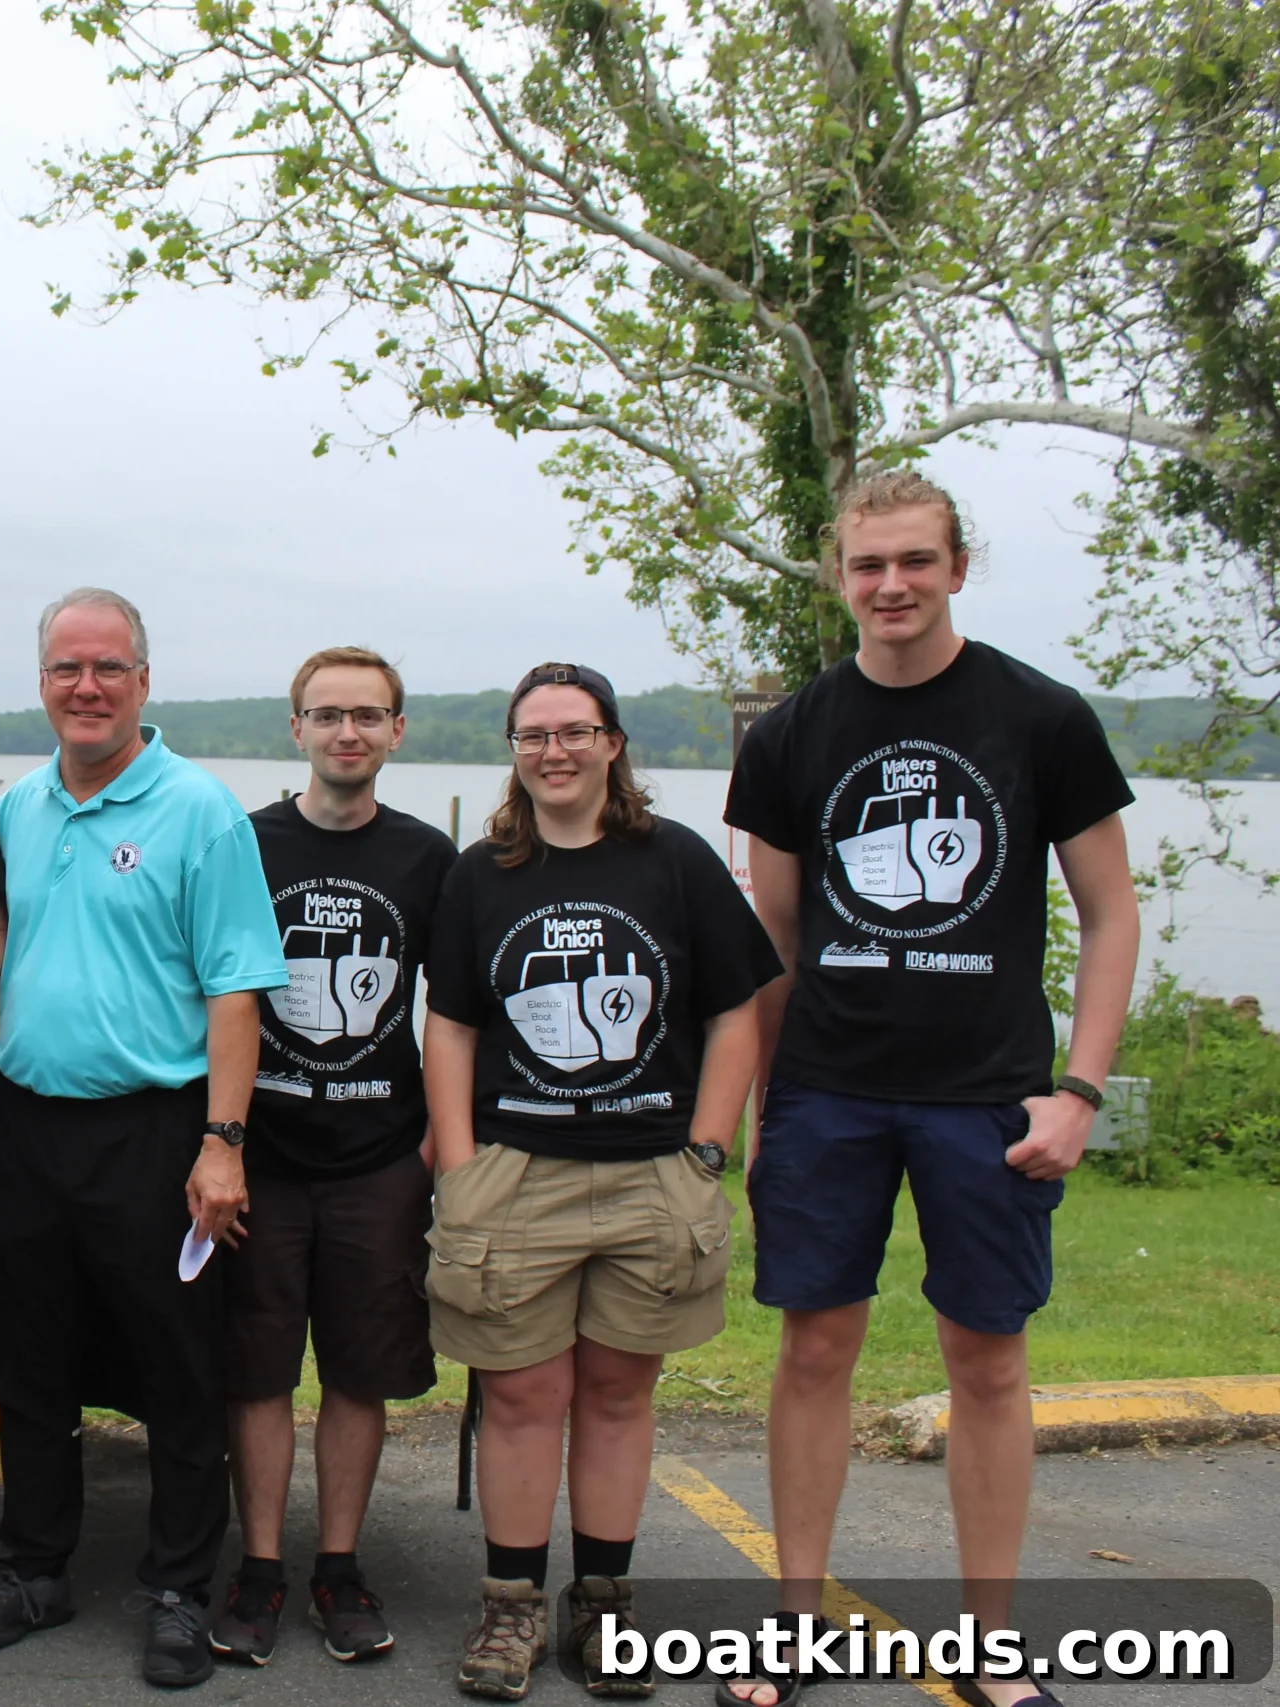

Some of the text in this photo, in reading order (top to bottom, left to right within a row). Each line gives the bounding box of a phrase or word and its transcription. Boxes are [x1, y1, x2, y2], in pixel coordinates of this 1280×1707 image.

[882, 758, 937, 775] Makers
[899, 739, 994, 797] WASHINGTON COLLEGE
[820, 744, 894, 830] WASHINGTON COLLEGE
[883, 772, 936, 793] Union
[862, 841, 895, 852] Electric
[862, 855, 883, 864] Boat
[969, 801, 1008, 911] WASHINGTON COLLEGE
[862, 866, 886, 874] Race
[276, 878, 319, 901] COLLEGE
[325, 877, 387, 904] WASHINGTON
[864, 878, 887, 886] Team
[305, 892, 362, 910] Makers
[304, 906, 362, 928] Union
[514, 904, 557, 931] COLLEGE
[543, 917, 602, 933] Makers
[858, 912, 970, 939] WASHINGTON COLLEGE
[563, 901, 661, 954] WASHINGTON COLLEGE
[543, 931, 604, 949] Union
[288, 973, 316, 982] ectric
[284, 995, 309, 1005] Race
[527, 999, 562, 1009] Electric
[287, 1008, 311, 1018] Team
[531, 1013, 552, 1021] Boat
[535, 1025, 558, 1034] Race
[538, 1038, 561, 1047] Team
[642, 1021, 668, 1062] COLLEGE
[286, 1043, 377, 1072] WASHINGTON COLLEGE
[536, 1066, 643, 1098] WASHINGTON COLLEGE
